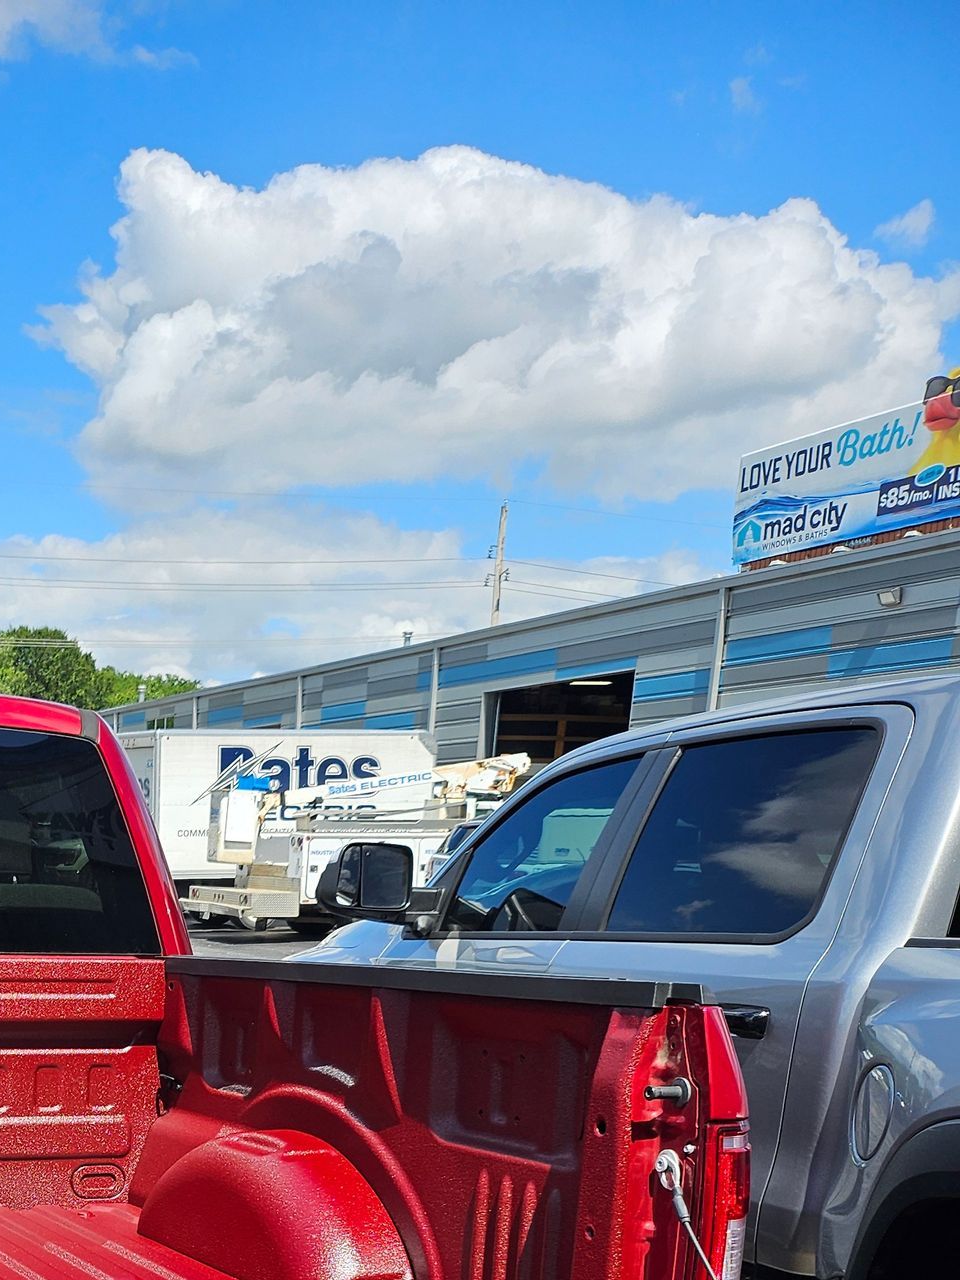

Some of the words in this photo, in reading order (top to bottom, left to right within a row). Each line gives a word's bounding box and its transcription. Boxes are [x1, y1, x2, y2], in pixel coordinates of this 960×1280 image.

[740, 456, 783, 493] LOVE
[785, 441, 832, 480] YOUR
[837, 411, 923, 467] Bath!
[879, 484, 932, 508] $85/mo.
[937, 482, 960, 500] INS
[763, 504, 808, 540] mad
[810, 501, 848, 533] city
[762, 536, 797, 551] WINDOWS
[805, 529, 829, 541] BATHS
[328, 783, 357, 795] Bates
[361, 772, 432, 790] ELECTRIC
[177, 829, 209, 838] COMM
